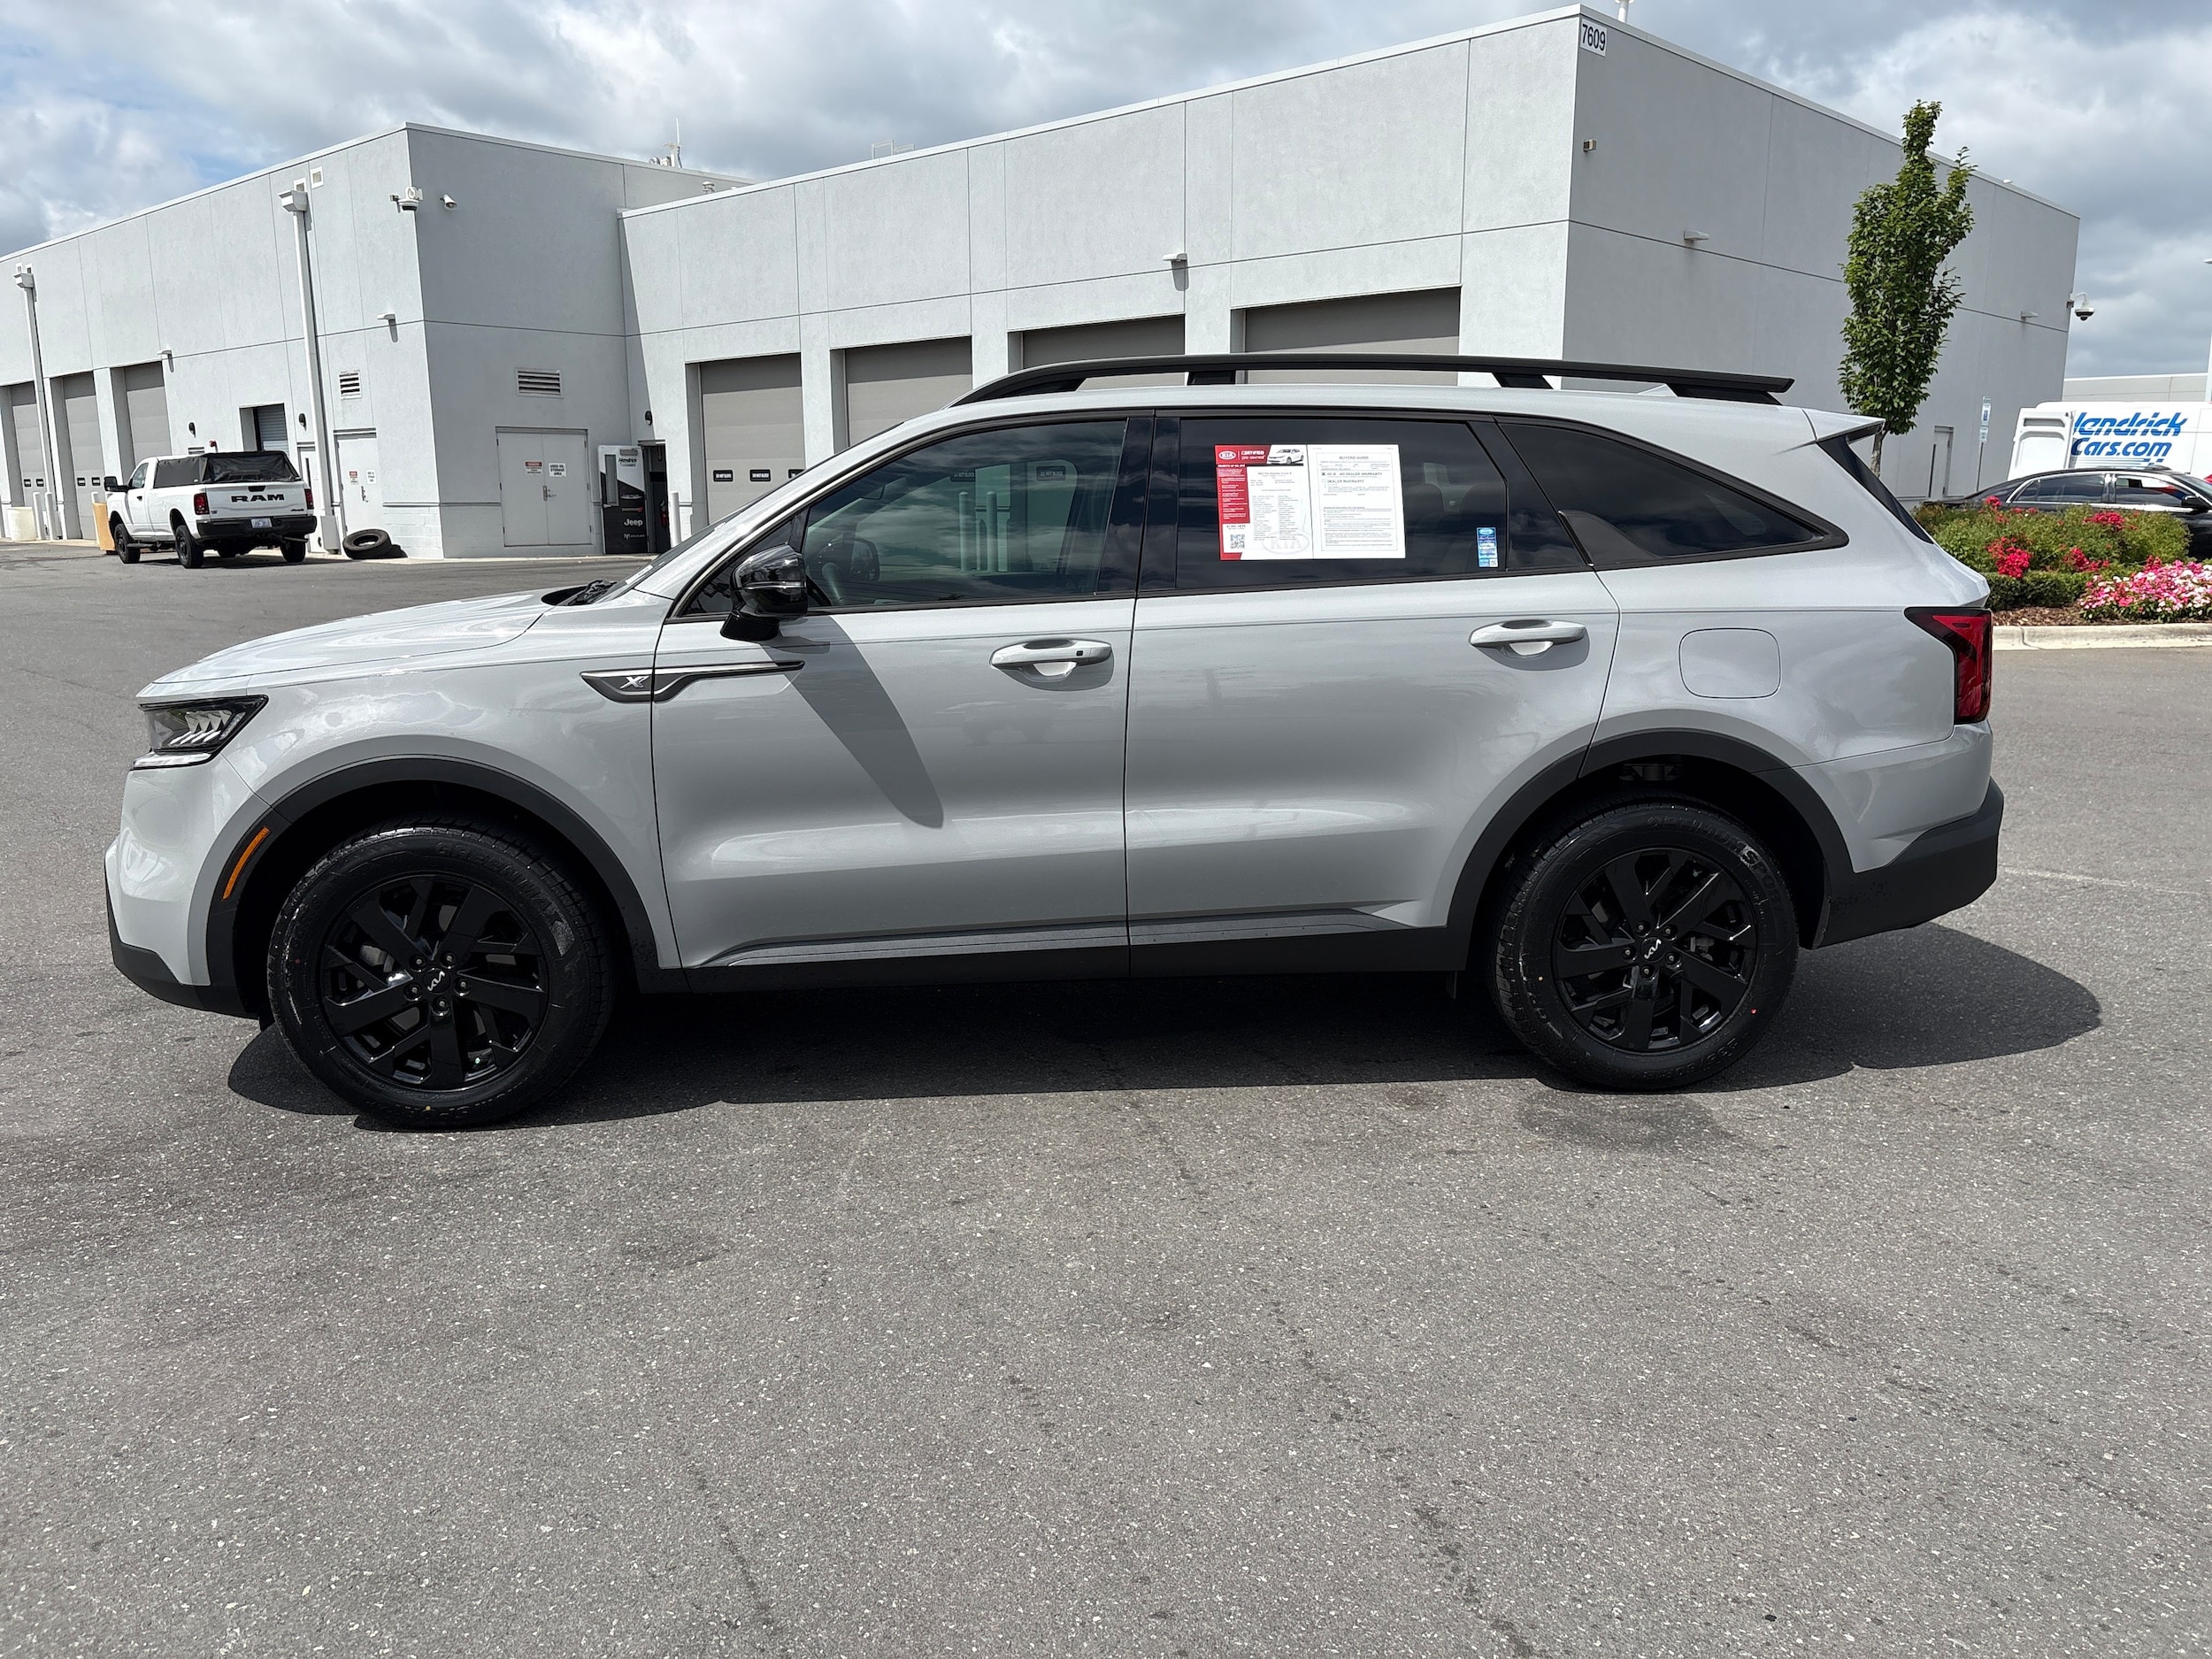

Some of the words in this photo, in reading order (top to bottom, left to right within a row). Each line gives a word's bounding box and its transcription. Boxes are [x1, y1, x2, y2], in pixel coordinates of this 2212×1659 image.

[1582, 23, 1606, 51] 7609
[2071, 436, 2172, 457] Cars.com
[231, 494, 284, 503] RAM
[624, 518, 643, 527] Jeep
